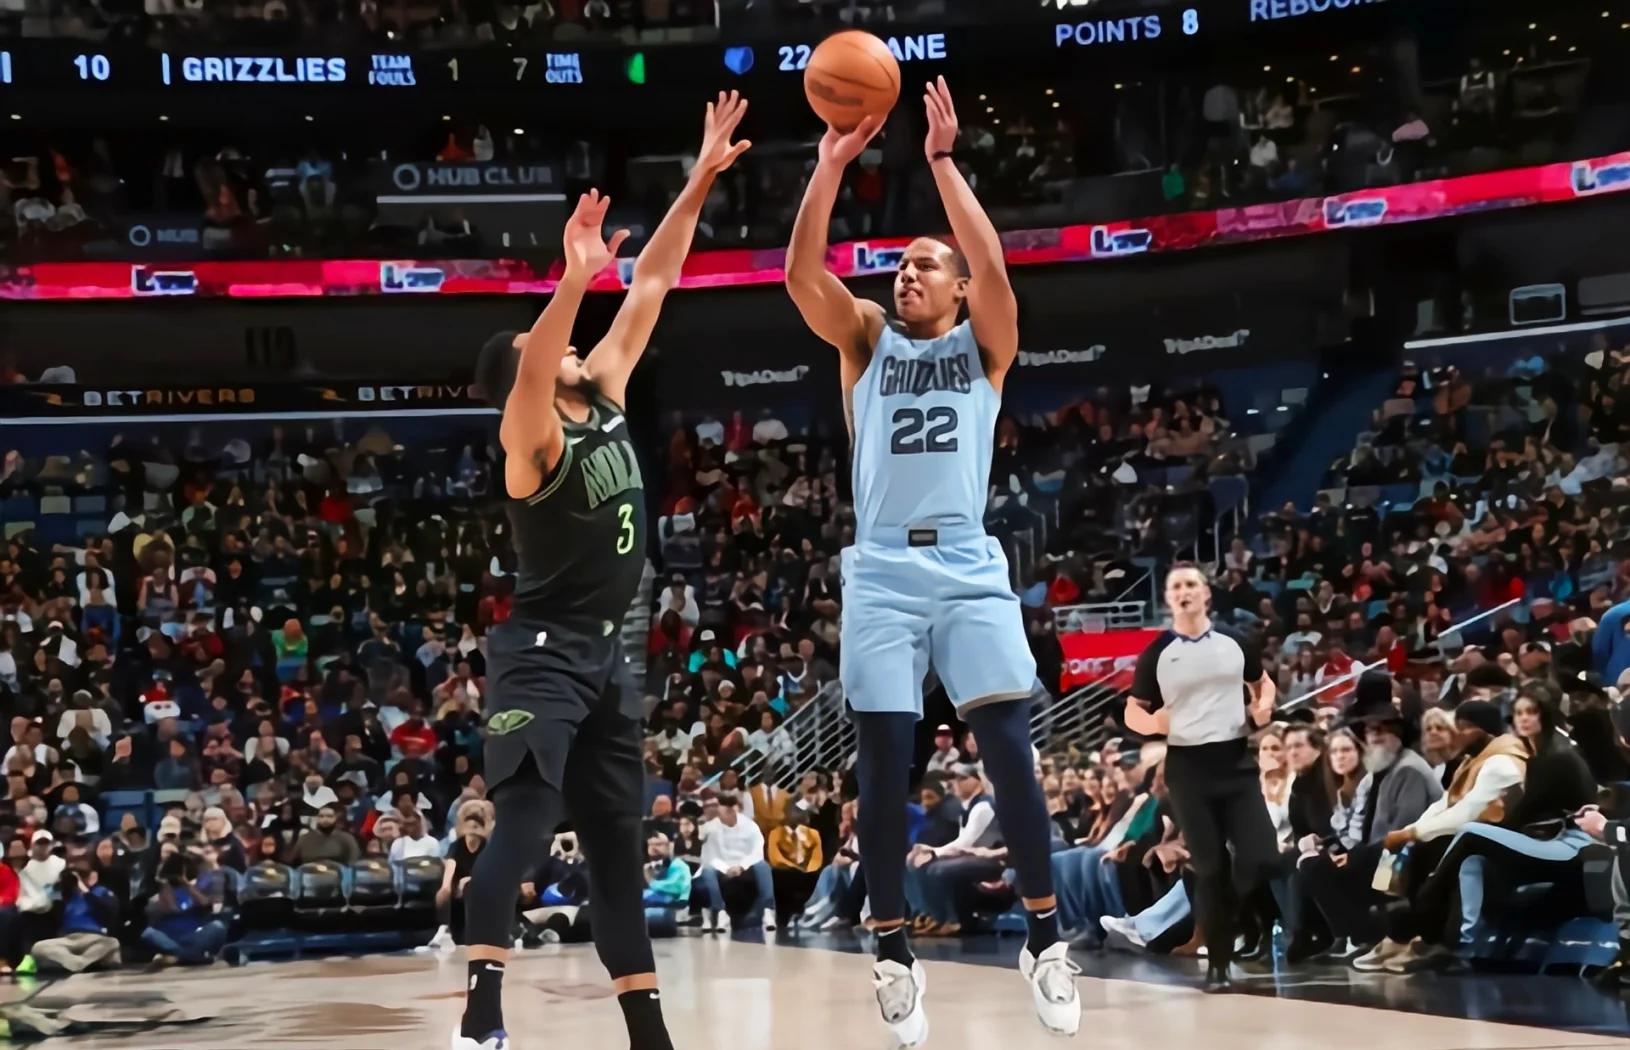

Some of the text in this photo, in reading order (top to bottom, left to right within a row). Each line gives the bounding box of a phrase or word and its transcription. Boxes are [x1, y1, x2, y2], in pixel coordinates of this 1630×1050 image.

[1055, 9, 1199, 47] POINTS 8
[371, 55, 411, 69] TEAM
[546, 53, 580, 67] TIME
[778, 33, 947, 71] 22 ANE
[74, 54, 110, 80] 10
[182, 56, 346, 82] GRIZZLIES
[368, 70, 416, 85] FOULS
[447, 58, 459, 81] 1
[513, 58, 528, 81] 7
[891, 406, 958, 455] 22
[616, 503, 635, 555] 3
